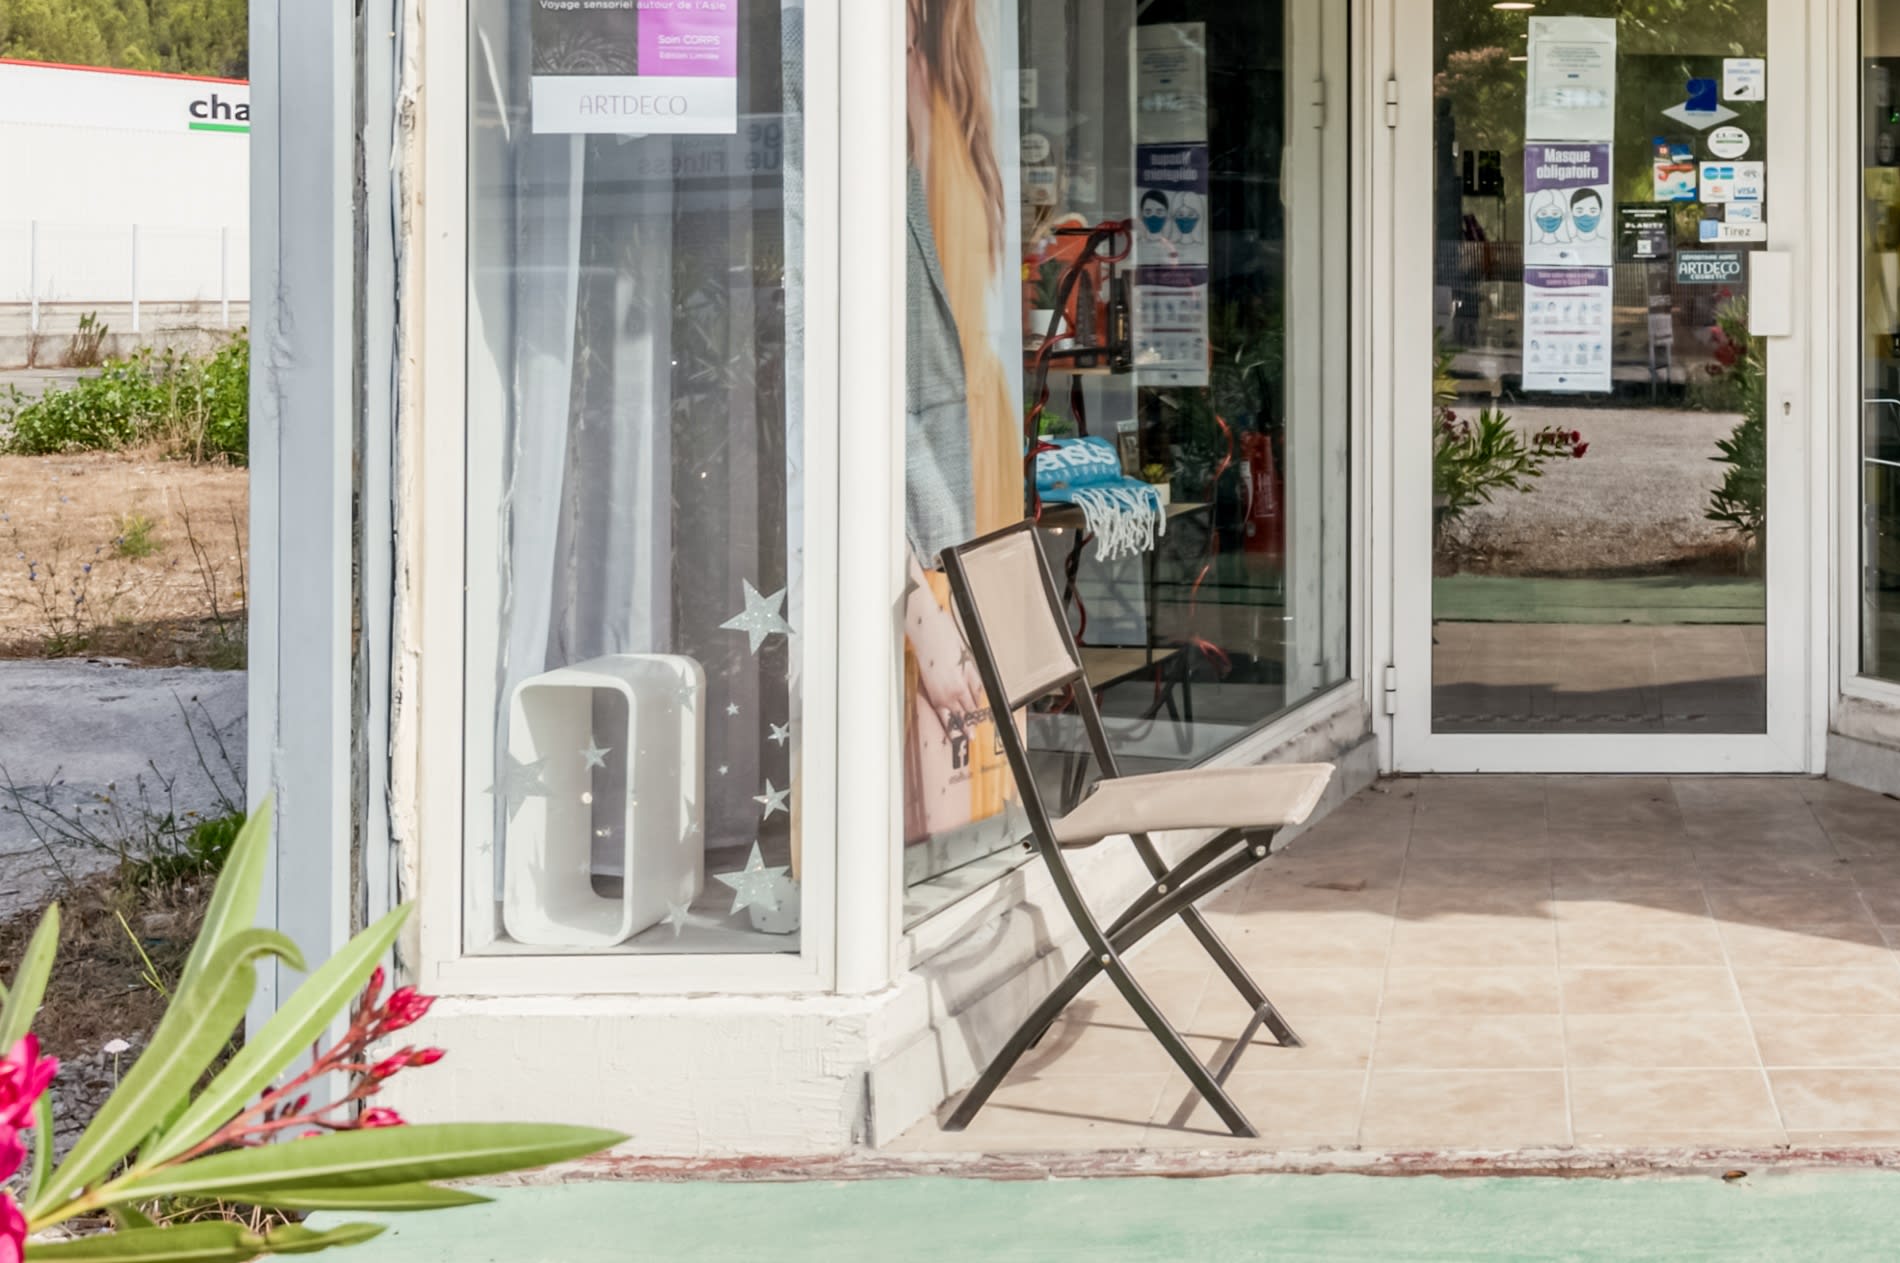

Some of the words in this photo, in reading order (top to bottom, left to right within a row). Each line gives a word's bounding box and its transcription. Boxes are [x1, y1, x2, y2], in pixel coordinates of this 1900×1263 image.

[539, 0, 580, 11] Voyage
[583, 0, 633, 9] sensoriel
[637, 1, 673, 9] autour
[677, 0, 692, 9] de
[579, 94, 688, 115] ARTDECO
[1544, 148, 1591, 164] Masque
[1536, 164, 1599, 181] obligatoire
[1724, 226, 1752, 237] Tirez
[1679, 261, 1741, 275] ARTDECO
